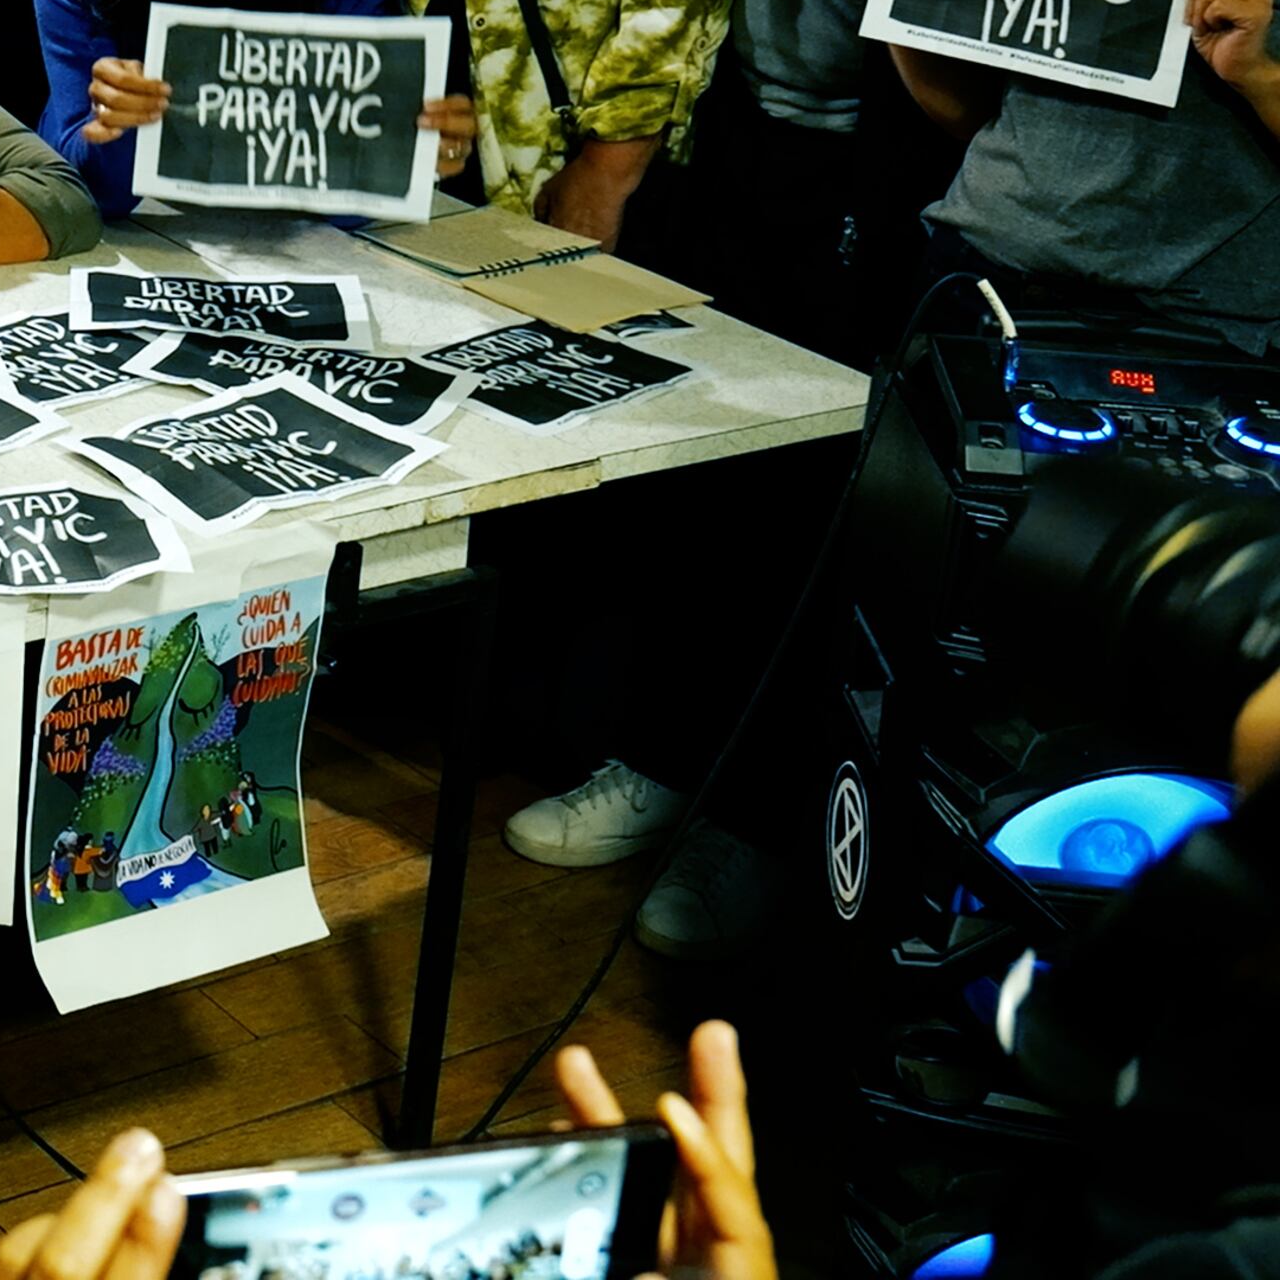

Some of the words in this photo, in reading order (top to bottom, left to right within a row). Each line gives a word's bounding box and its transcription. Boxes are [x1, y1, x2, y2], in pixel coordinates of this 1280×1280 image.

[219, 29, 383, 94] LIBERTAD
[196, 83, 297, 135] PARA
[308, 90, 383, 140] VIC
[141, 276, 296, 306] LIBERTAD
[38, 331, 120, 365] VIC
[243, 344, 407, 378] LIBERTAD
[432, 328, 554, 369] LIBERTAD
[314, 370, 400, 405] VIC
[13, 512, 108, 544] VIC
[291, 611, 302, 634] A
[55, 628, 122, 671] BASTA
[126, 625, 146, 651] DE
[274, 636, 309, 666] QUE
[68, 691, 79, 708] A
[82, 685, 103, 704] LAS
[54, 732, 69, 754] DE
[76, 726, 90, 745] LA
[46, 744, 90, 775] VIDA
